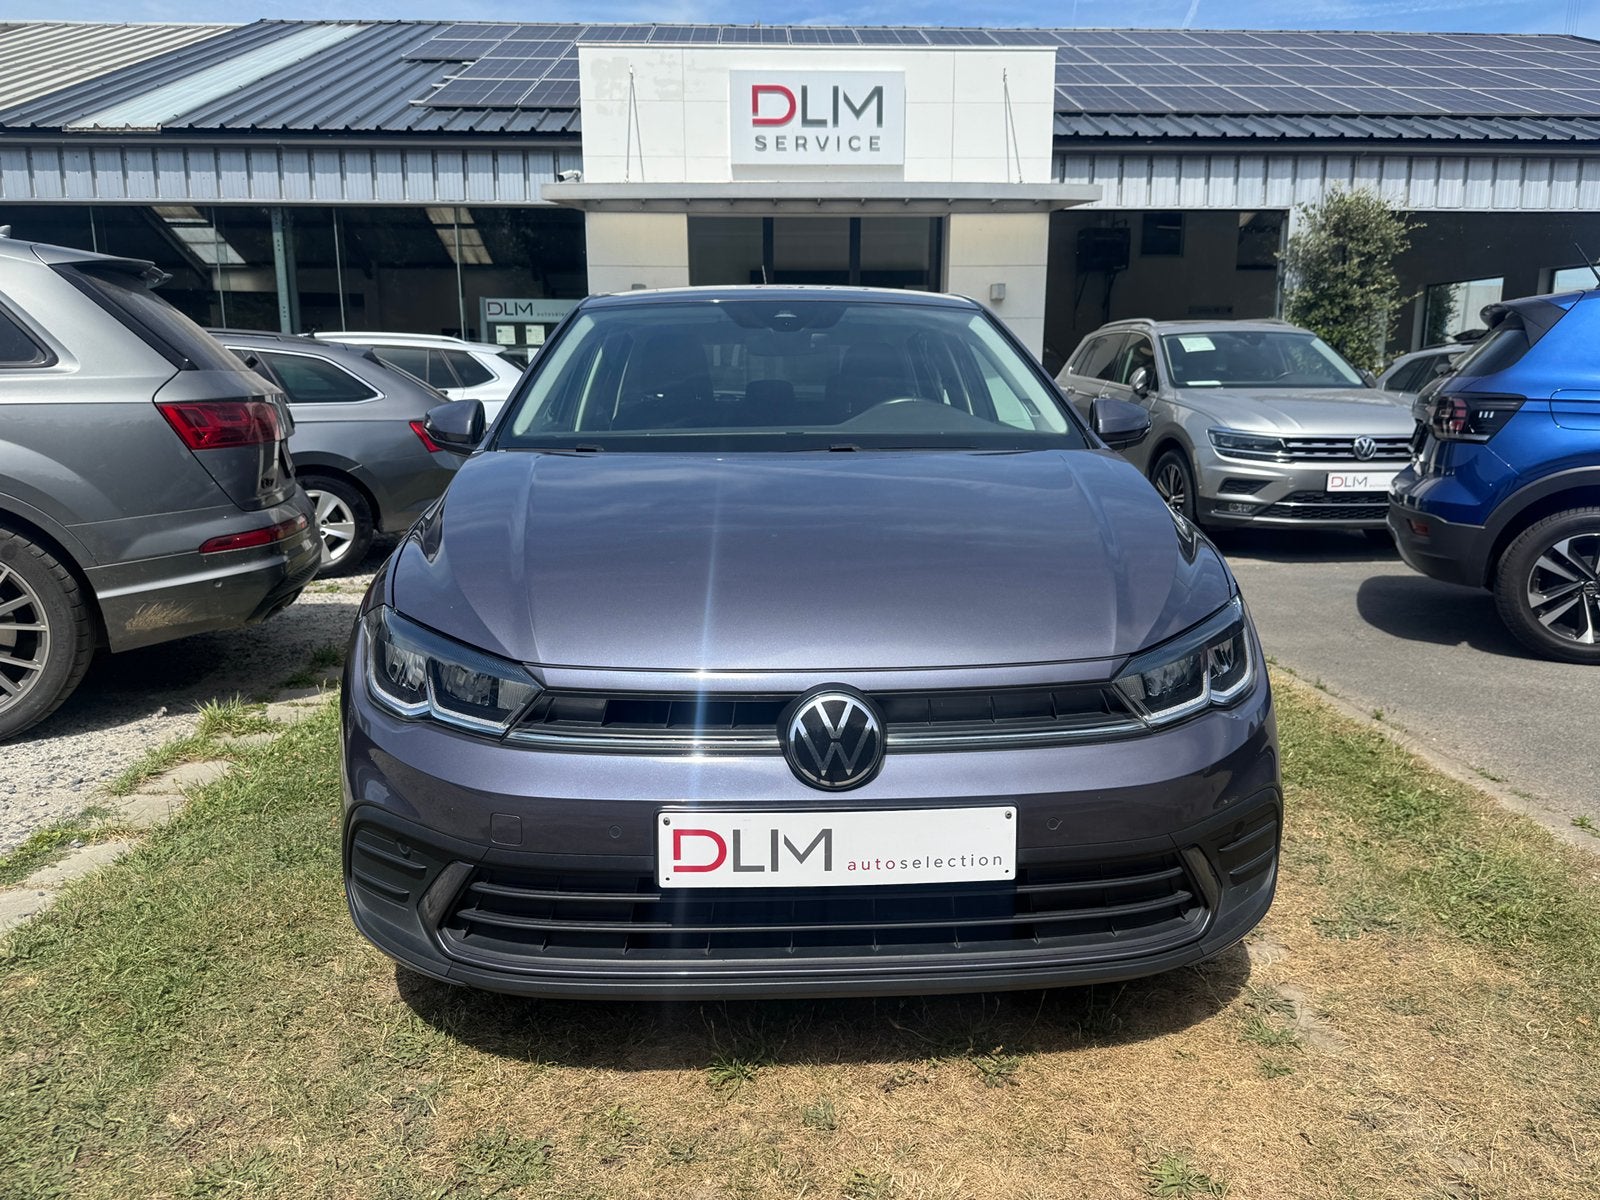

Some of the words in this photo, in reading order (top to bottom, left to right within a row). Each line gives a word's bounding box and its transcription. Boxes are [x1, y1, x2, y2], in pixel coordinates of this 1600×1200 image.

[752, 85, 883, 127] DLM
[754, 135, 881, 152] SERVICE
[487, 302, 533, 316] DLM
[673, 828, 833, 873] DLM
[847, 853, 1003, 871] autoselection
